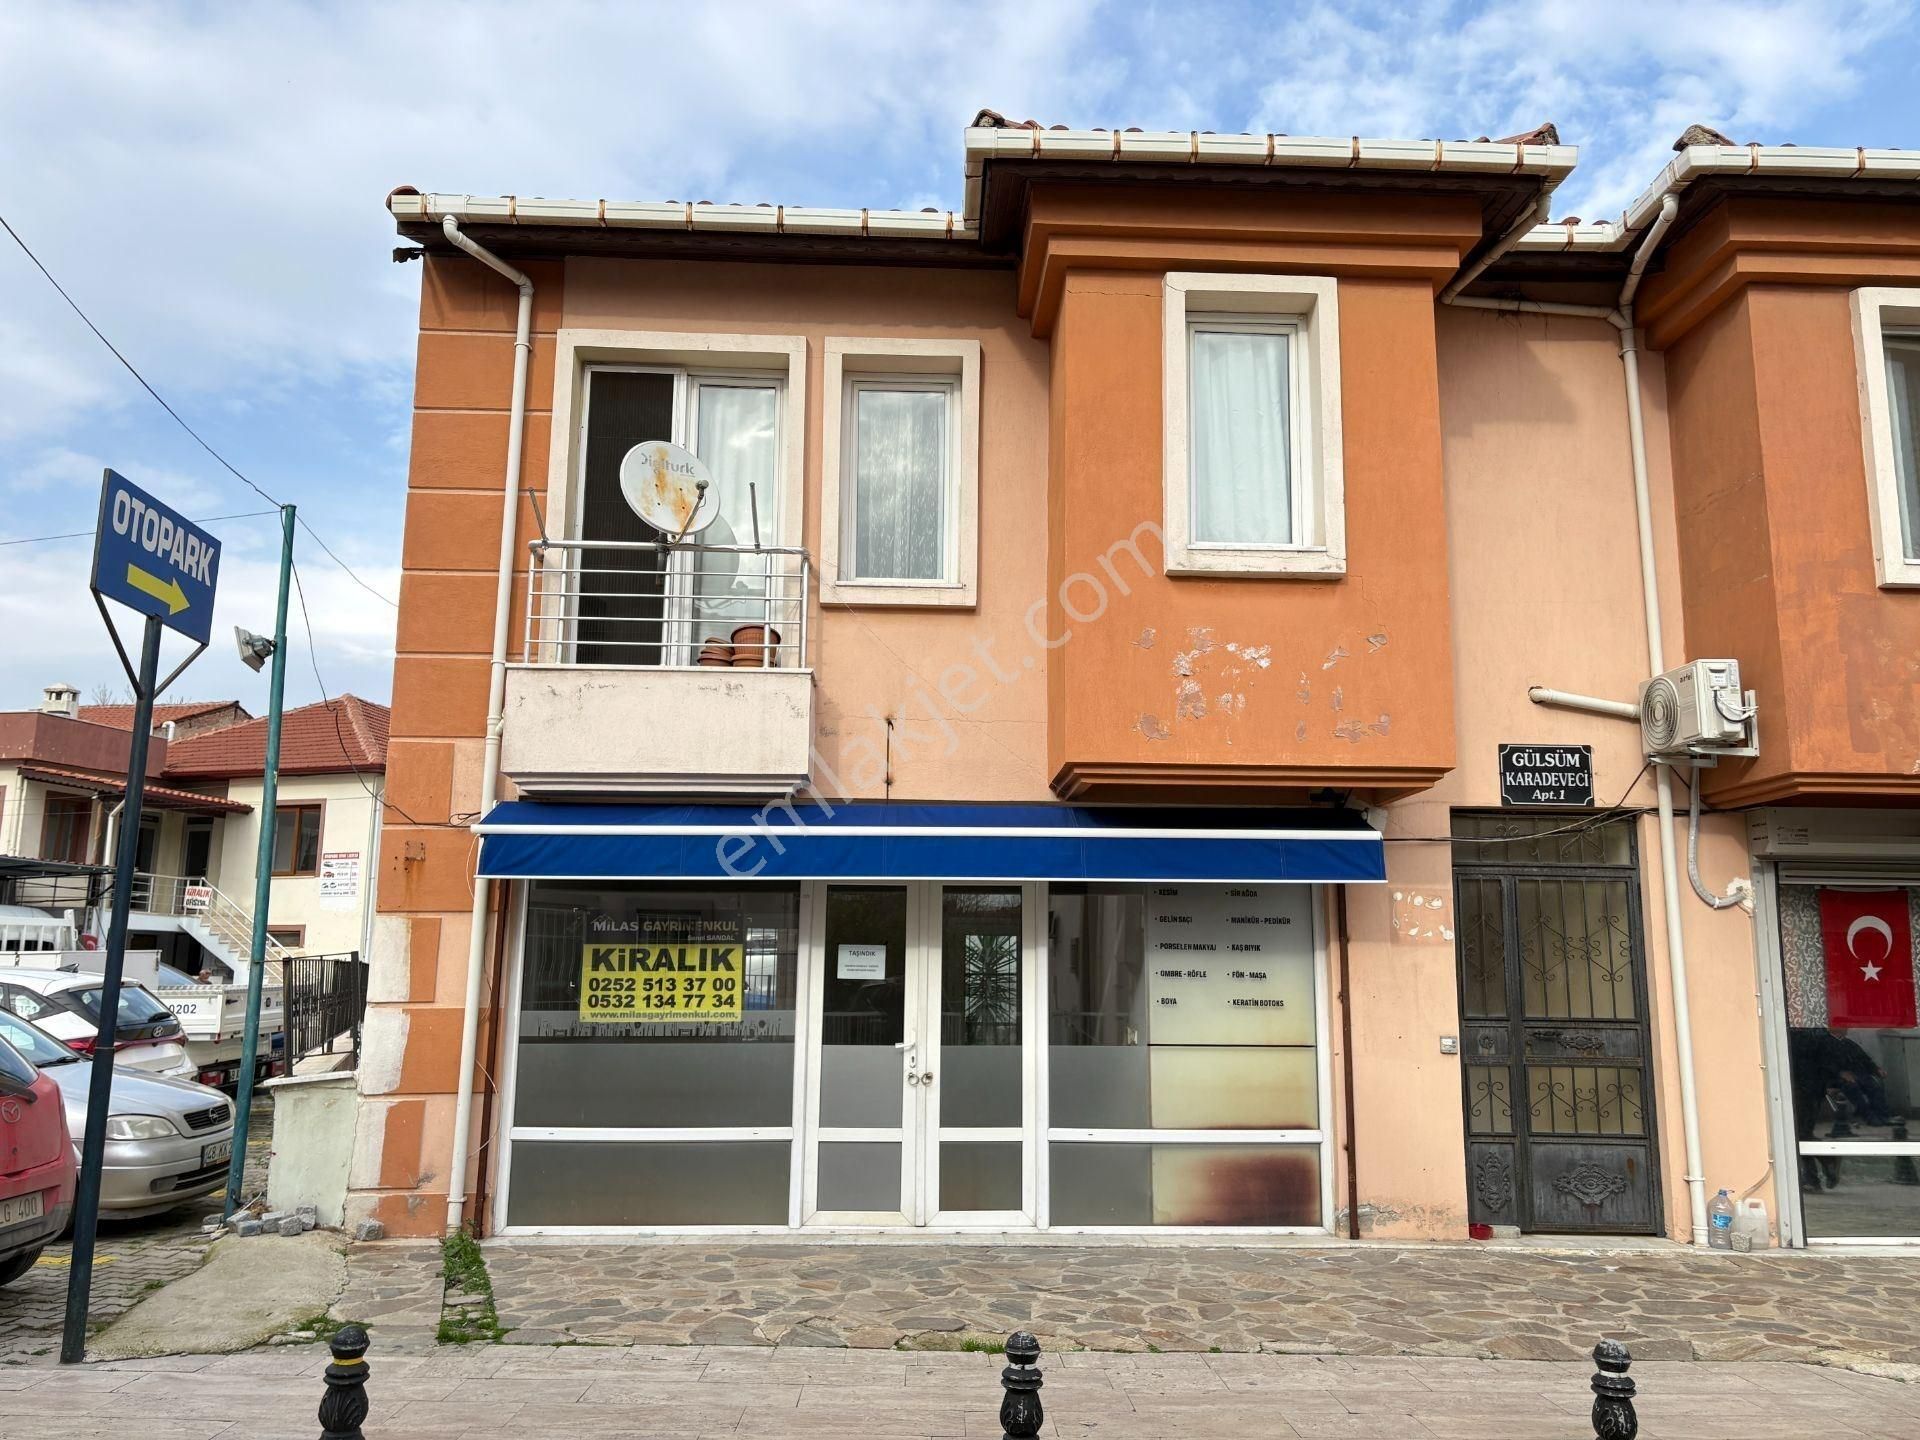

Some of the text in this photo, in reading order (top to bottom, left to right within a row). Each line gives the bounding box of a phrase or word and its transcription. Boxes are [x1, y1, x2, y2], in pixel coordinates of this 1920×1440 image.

[112, 489, 215, 588] OTOPARK
[1512, 749, 1580, 767] GÜLSÜM
[1505, 770, 1589, 787] KARADEVECİ
[1532, 789, 1565, 801] Apt. 1
[1159, 915, 1178, 923] GELİN
[1230, 916, 1260, 924] MANİKÜR
[1264, 917, 1291, 925] PEDİKÜR
[1231, 944, 1244, 952] KAŞ
[1187, 970, 1207, 978] RÖFLE
[1249, 971, 1267, 980] MAŞA
[588, 978, 736, 992] 0252 513 37 00
[587, 994, 736, 1008] 0532 134 77 34
[1232, 998, 1284, 1007] KERATİN BOTOKS
[590, 1010, 736, 1021] www.milasgayrimenkul.com
[18, 1196, 38, 1219] 400
